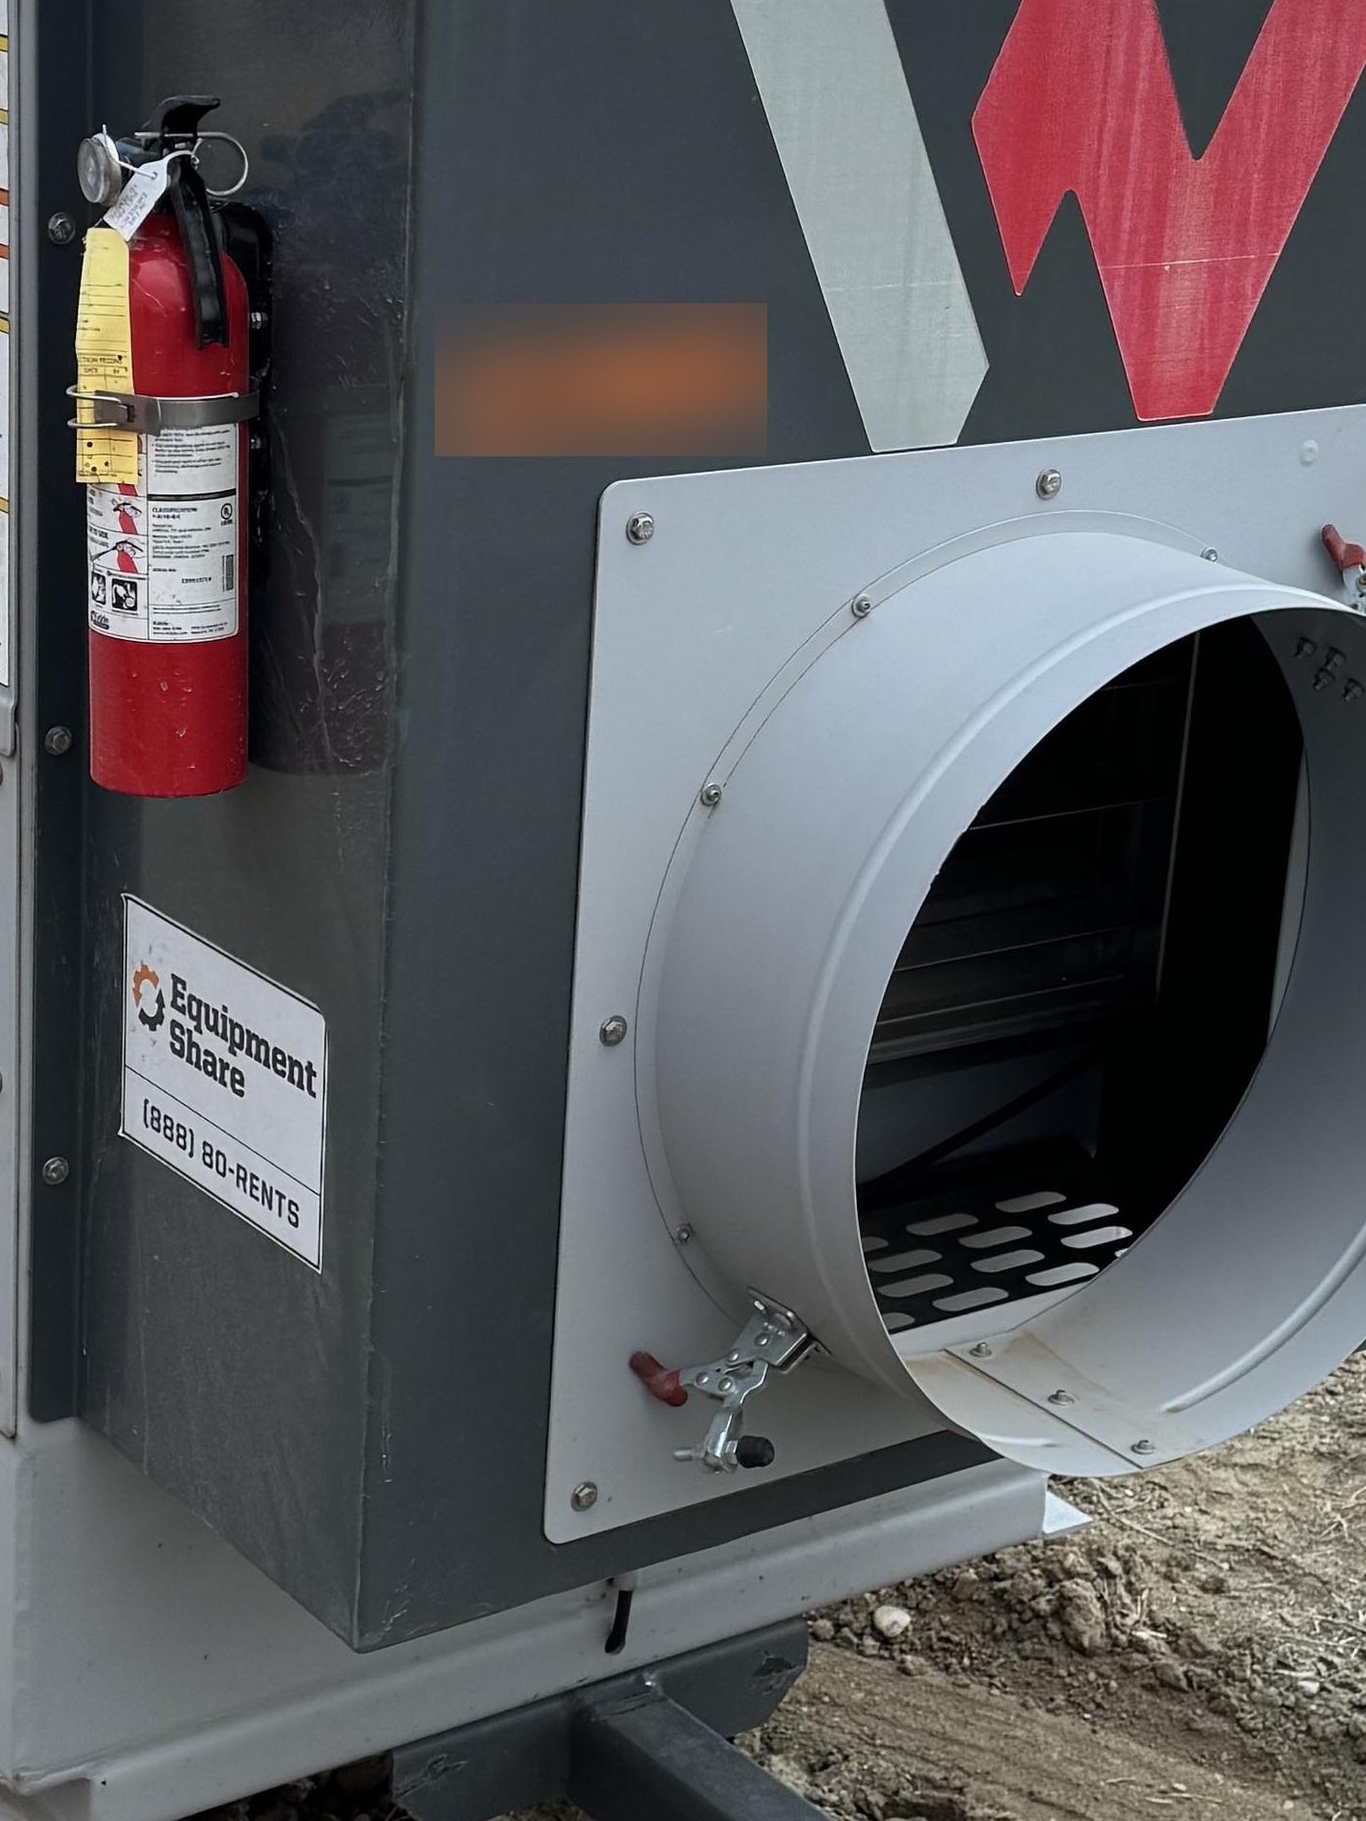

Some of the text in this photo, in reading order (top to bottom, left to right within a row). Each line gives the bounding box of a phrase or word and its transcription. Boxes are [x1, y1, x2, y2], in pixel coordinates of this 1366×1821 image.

[169, 1019, 246, 1098] Share
[170, 972, 317, 1098] Equipment
[143, 1098, 300, 1229] (888) 80-RENTS
